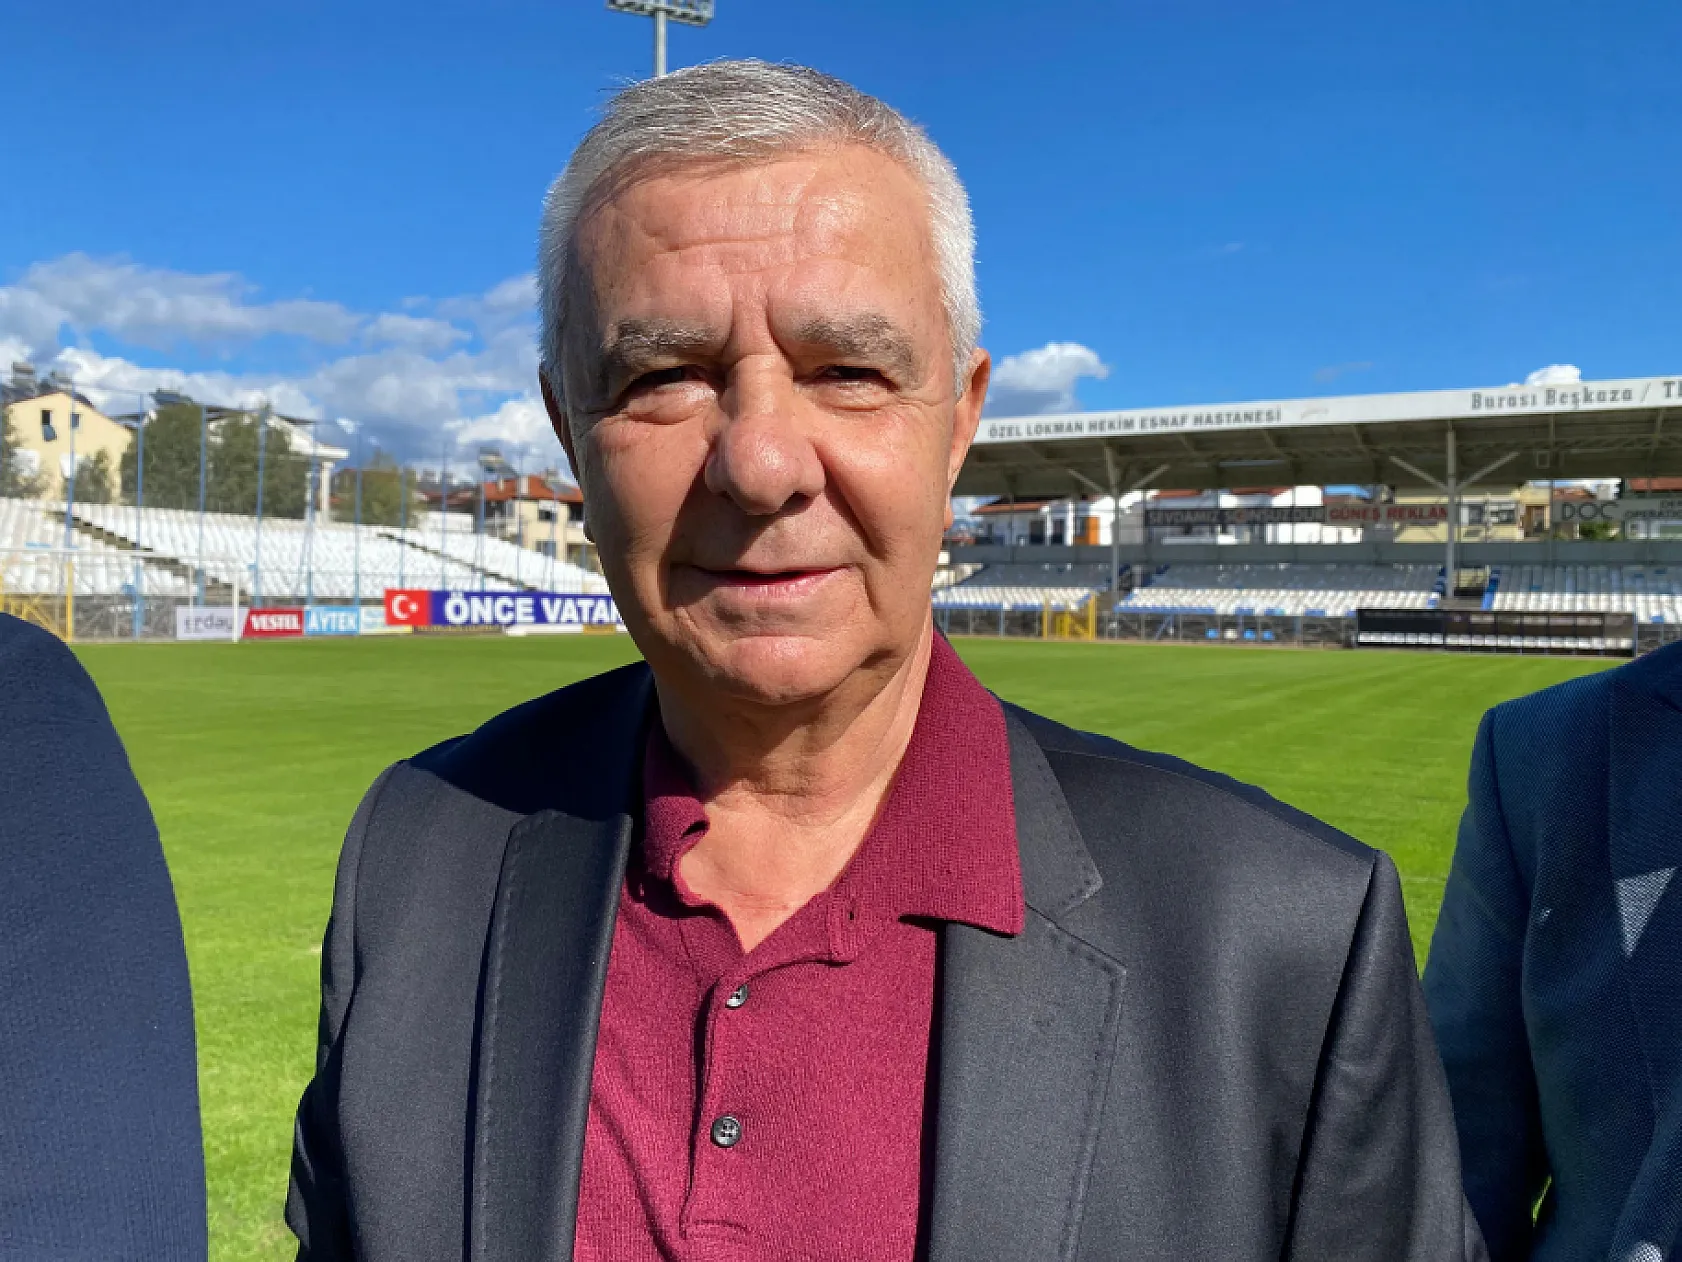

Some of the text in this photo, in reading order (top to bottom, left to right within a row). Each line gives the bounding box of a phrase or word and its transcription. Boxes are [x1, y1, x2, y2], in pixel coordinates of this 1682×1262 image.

[1545, 386, 1633, 410] Beşkaza
[989, 404, 1282, 438] ÖZEL LOKMAN HEKİM ESNAF HASTANESİ
[1329, 506, 1381, 522] GÜNEŞ
[1562, 502, 1619, 520] DOC
[444, 591, 535, 625] ÖNCE
[251, 613, 301, 631] VESTEL
